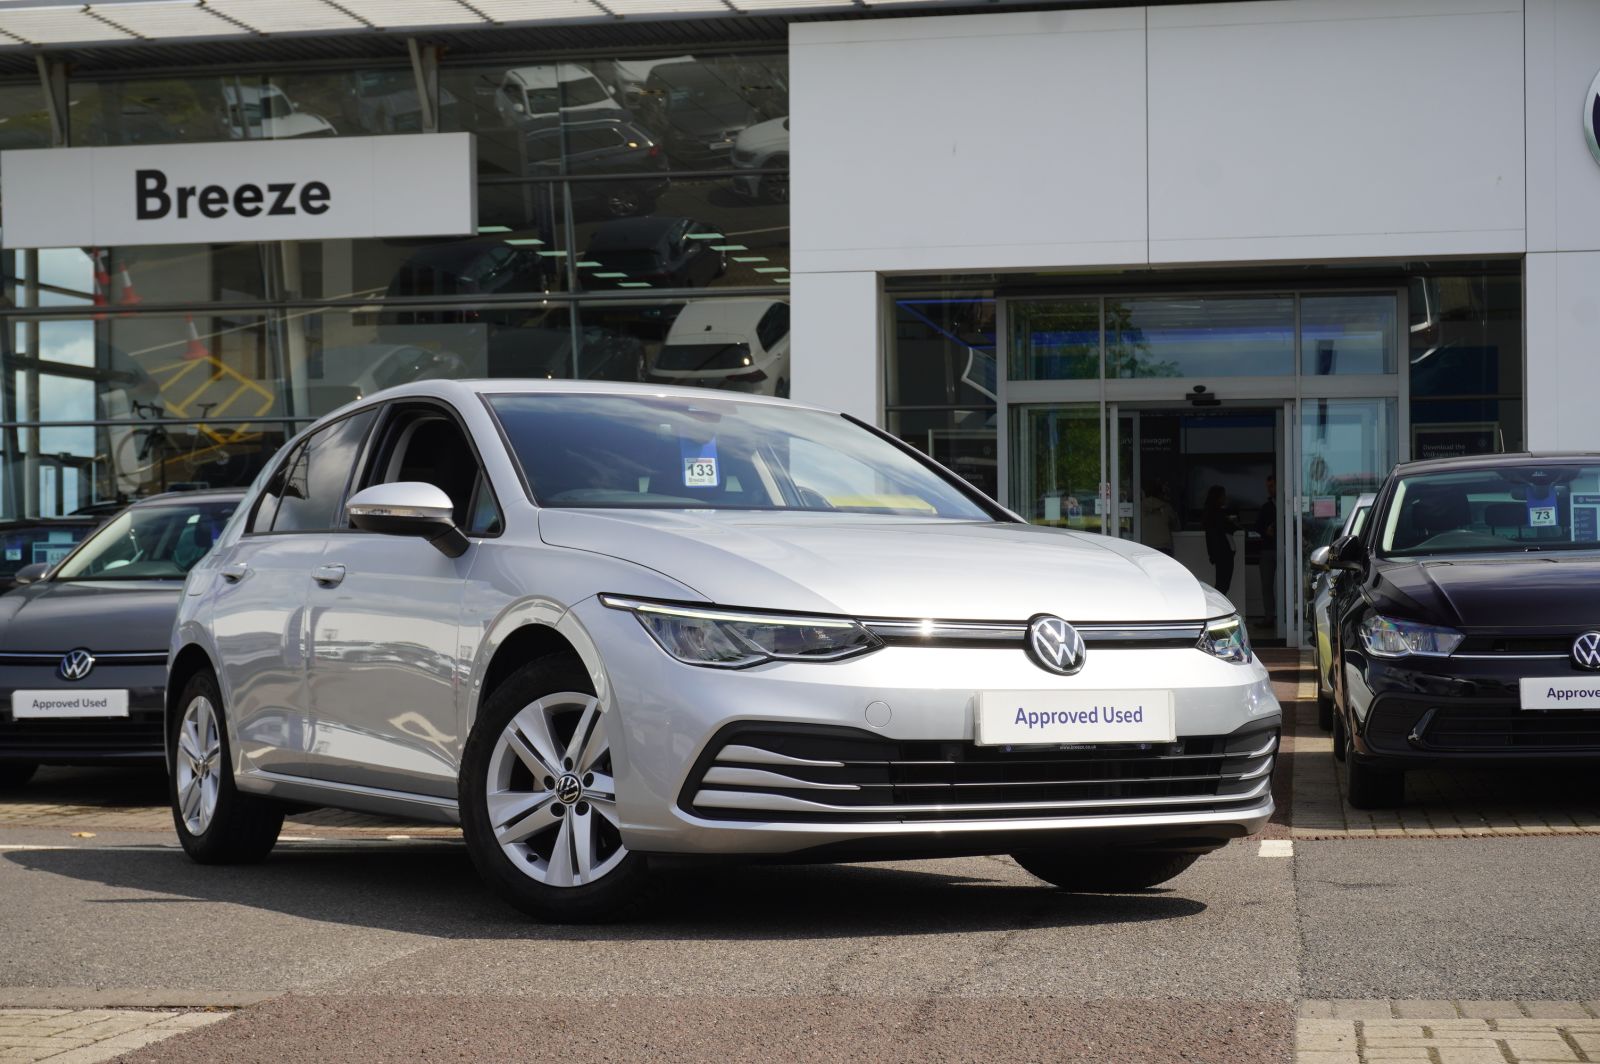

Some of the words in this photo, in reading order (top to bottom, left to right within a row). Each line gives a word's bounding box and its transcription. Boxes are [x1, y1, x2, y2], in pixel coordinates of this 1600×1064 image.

[136, 168, 332, 221] Breeze
[688, 464, 714, 476] 133
[1535, 511, 1550, 520] 73
[1030, 615, 1085, 673] VW
[62, 650, 94, 679] VW
[32, 698, 80, 709] Approved
[82, 698, 107, 708] Used
[1015, 706, 1098, 728] Approved
[1103, 706, 1143, 723] Used
